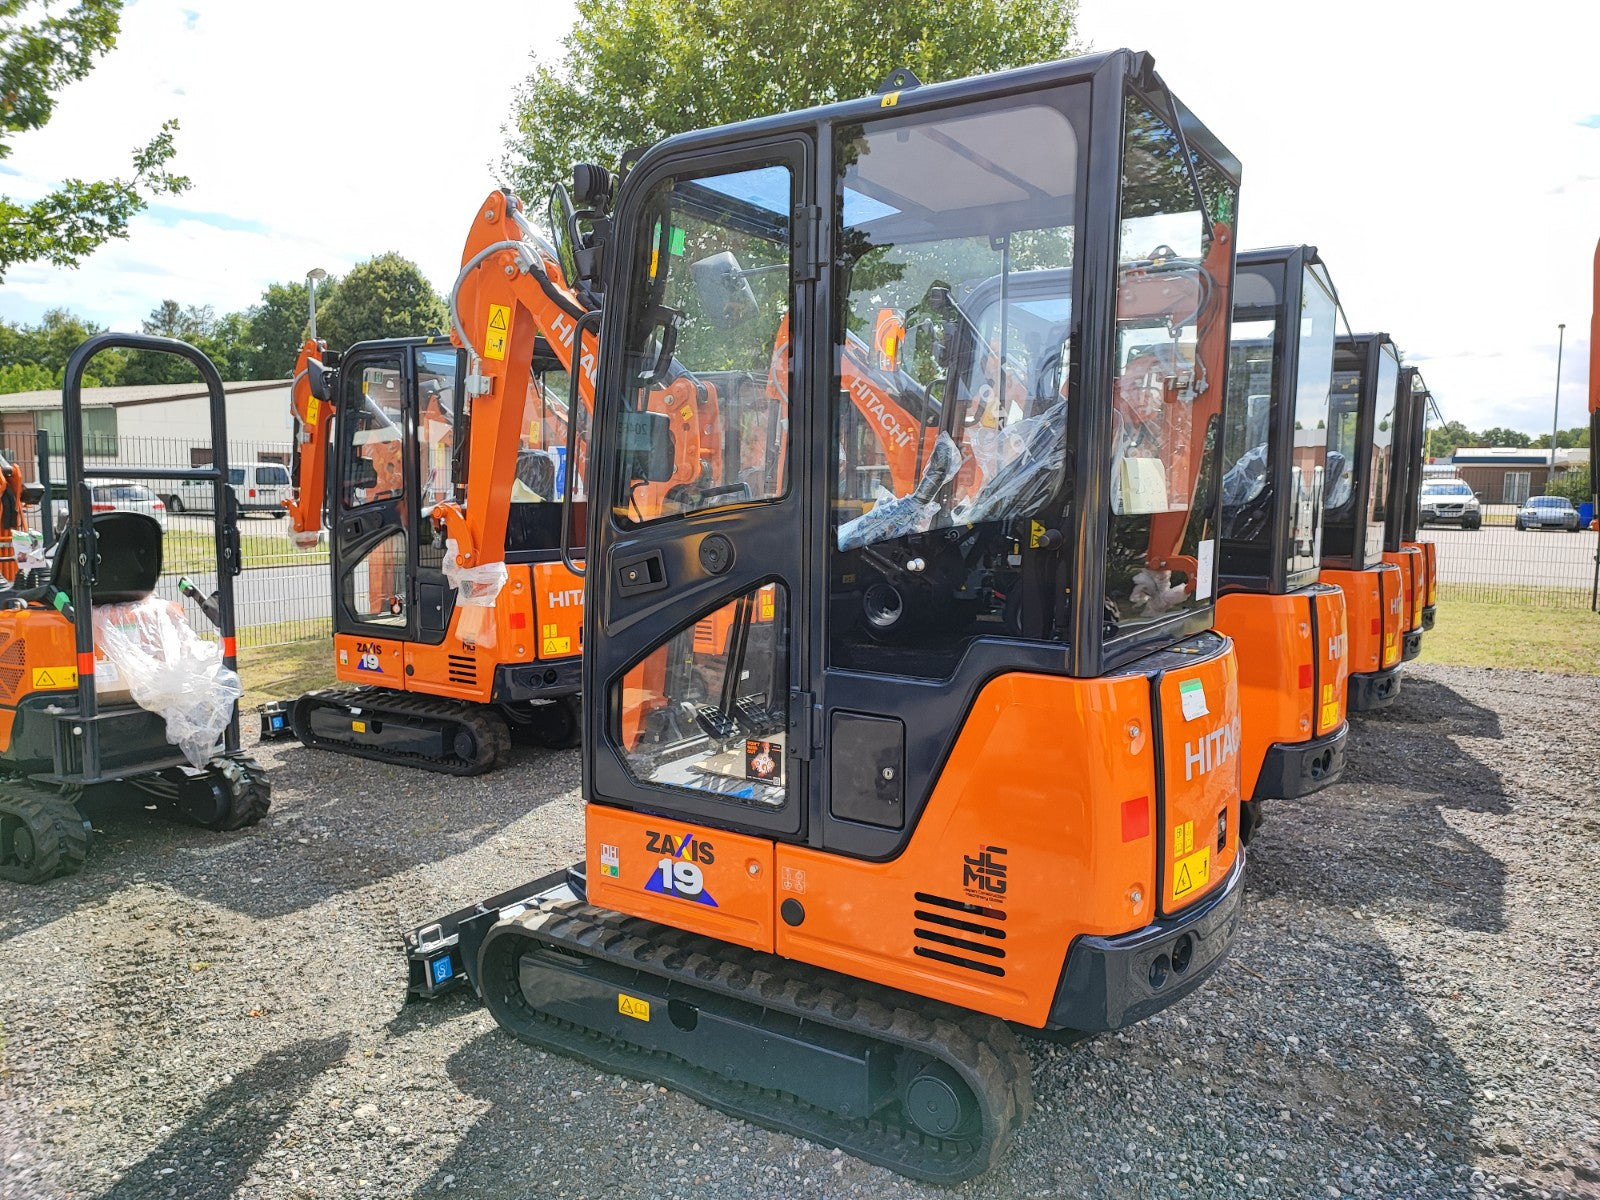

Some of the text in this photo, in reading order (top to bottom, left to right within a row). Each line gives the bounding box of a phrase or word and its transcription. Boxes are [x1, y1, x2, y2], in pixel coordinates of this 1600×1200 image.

[850, 376, 911, 448] HITACHI
[356, 642, 382, 655] ZAXIS
[361, 653, 379, 671] 19
[646, 830, 715, 865] ZAXIS
[658, 858, 704, 900] 19
